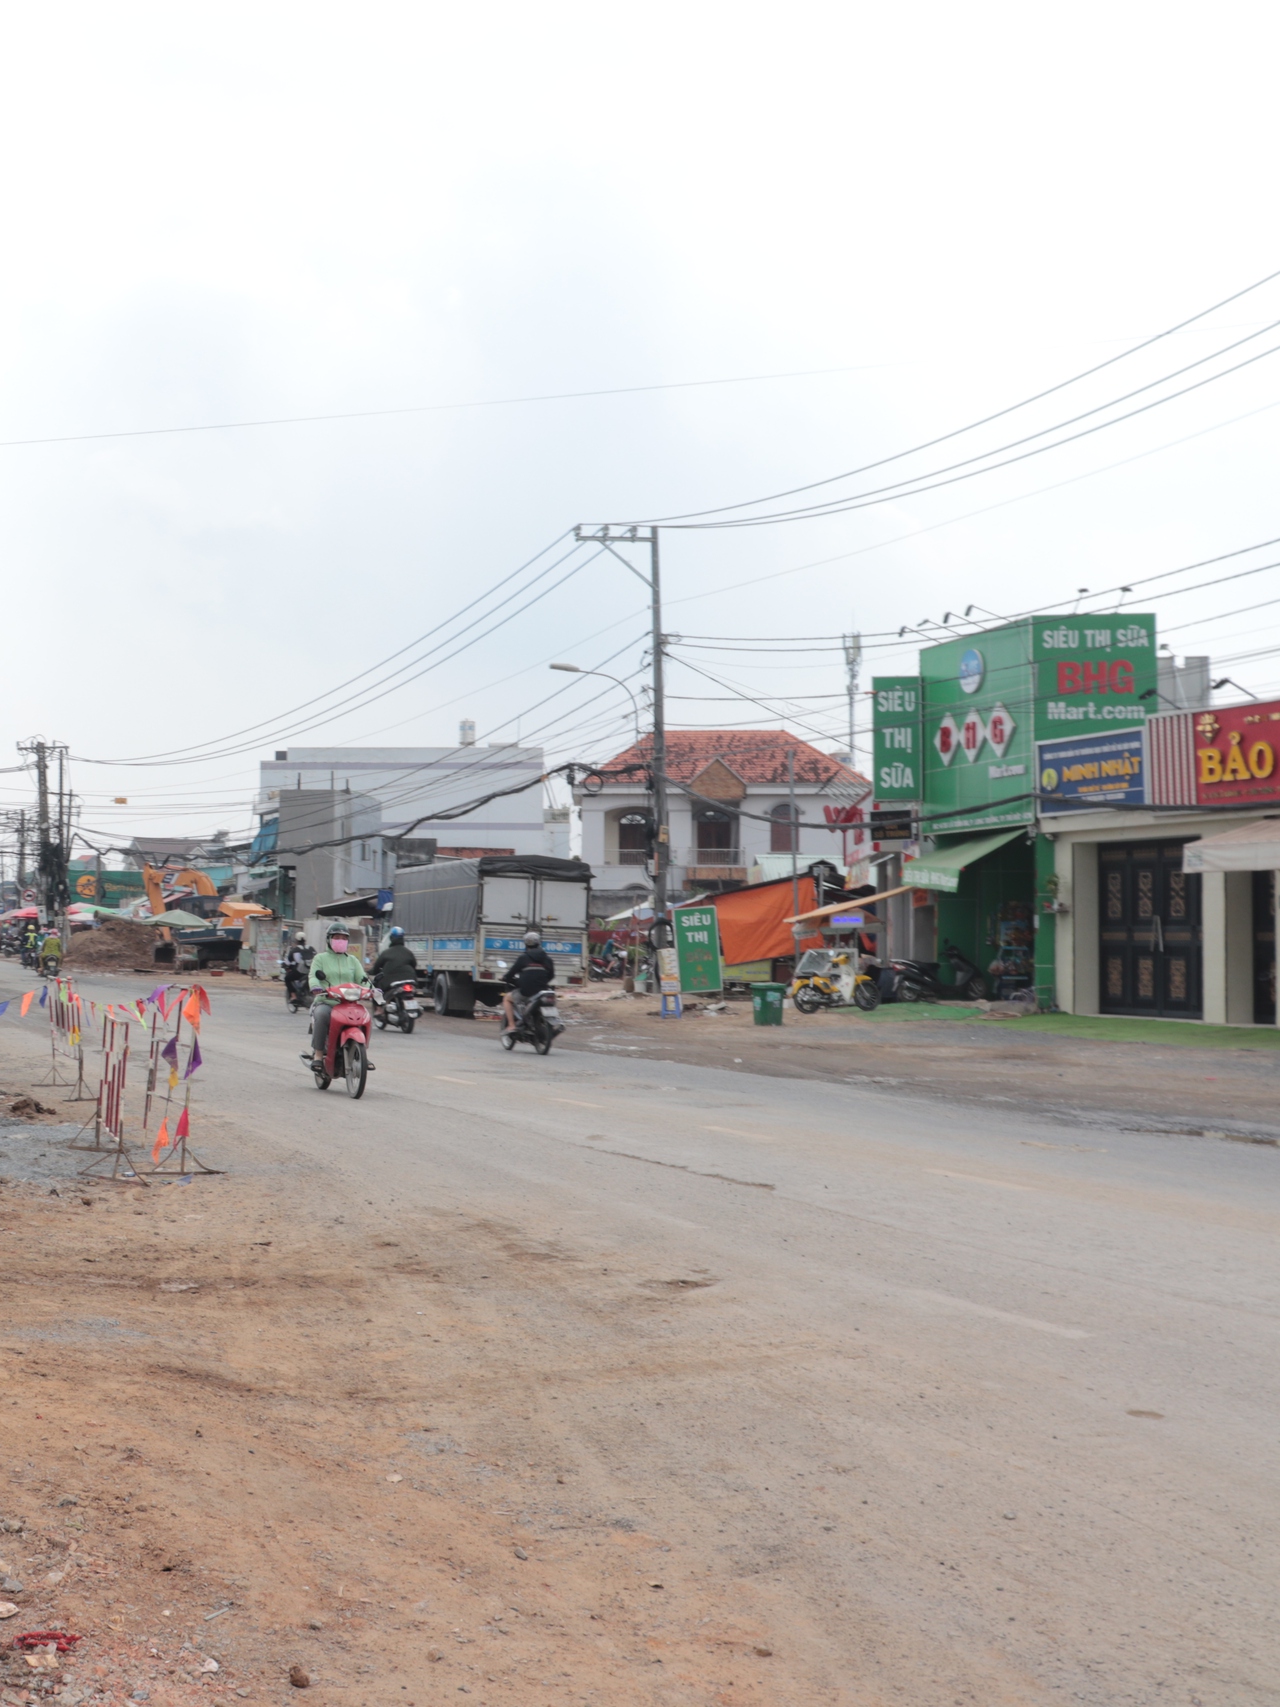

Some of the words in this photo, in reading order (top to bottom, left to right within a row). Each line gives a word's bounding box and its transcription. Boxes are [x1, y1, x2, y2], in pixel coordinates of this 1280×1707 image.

[1042, 625, 1079, 648] SIÊU
[1083, 629, 1112, 652] THỊ
[1116, 625, 1149, 647] SỮA
[1057, 659, 1135, 695] BHG
[876, 686, 916, 712] SIÊU
[1047, 702, 1146, 719] Mart.com
[882, 727, 912, 753] THỊ
[1062, 762, 1099, 782] MINH
[1101, 751, 1141, 780] NHẬT
[1197, 731, 1274, 784] BẢO
[879, 762, 915, 788] SỮA
[681, 912, 711, 927] SIÊU
[685, 931, 708, 944] THỊ
